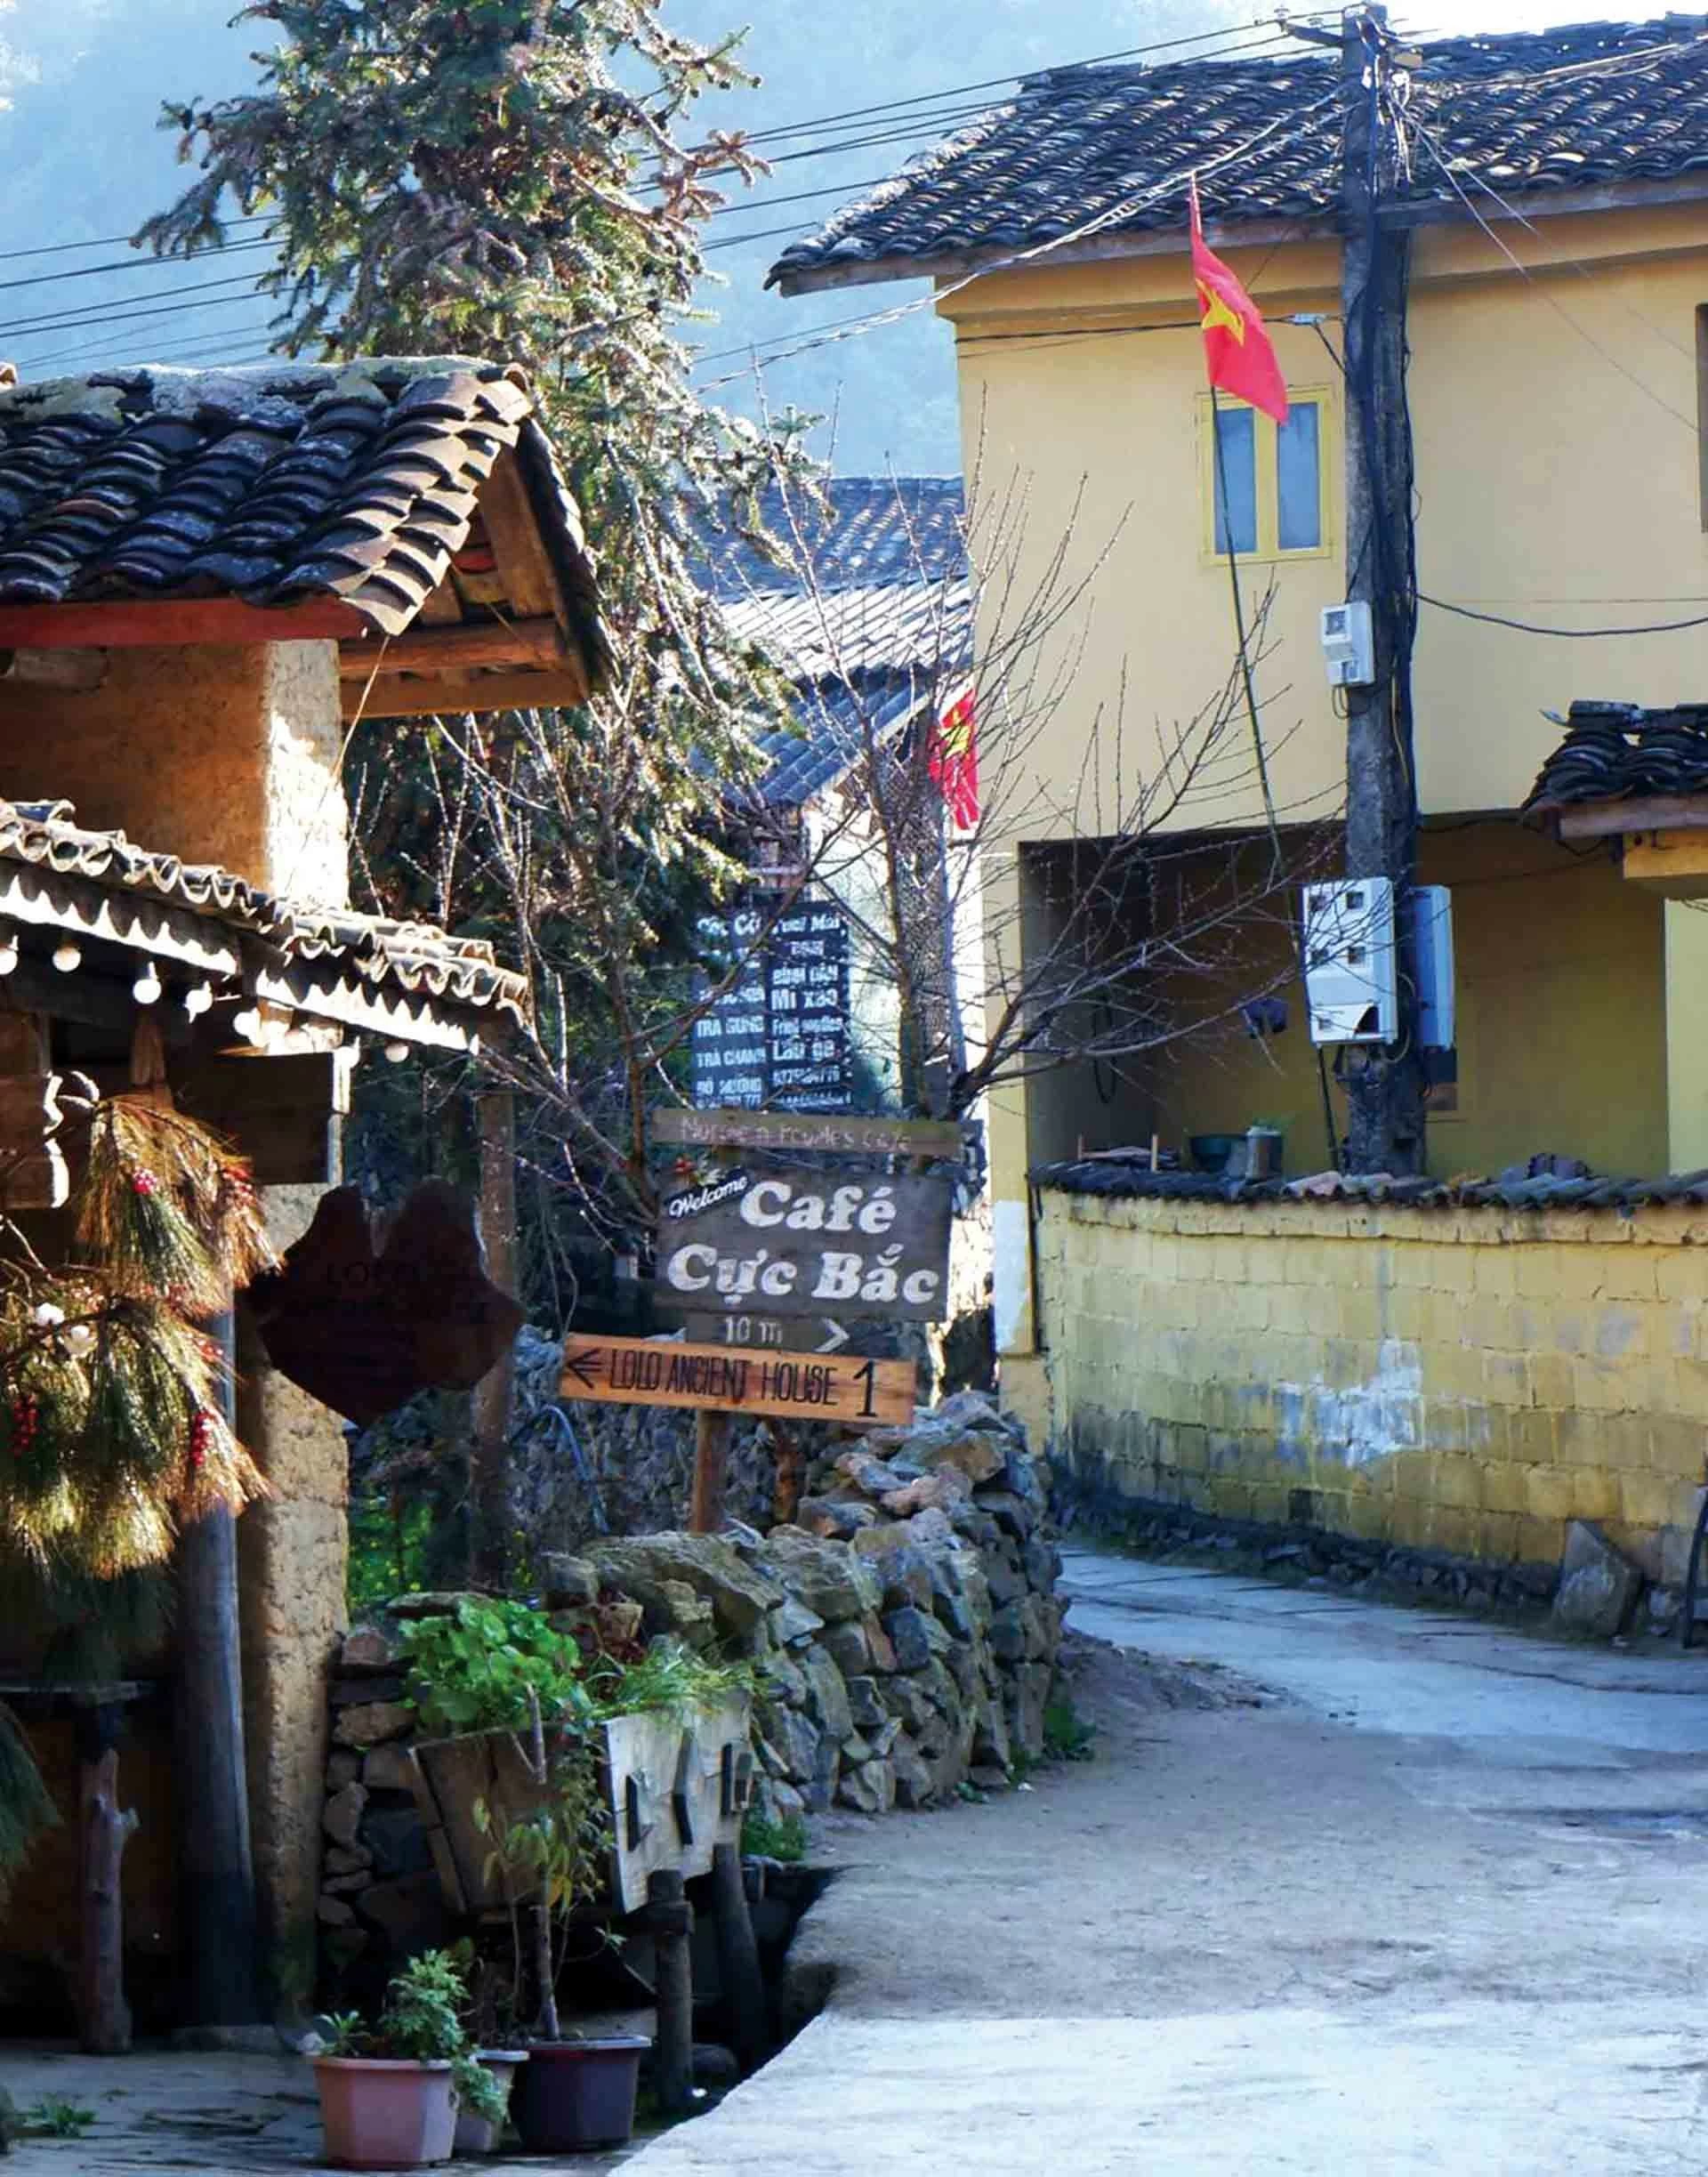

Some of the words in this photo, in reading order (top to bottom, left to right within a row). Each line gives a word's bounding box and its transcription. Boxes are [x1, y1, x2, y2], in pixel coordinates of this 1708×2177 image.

[668, 1175, 748, 1218] Welcome
[740, 1181, 897, 1234] Café
[667, 1244, 798, 1305] Cực
[810, 1243, 940, 1304] Bắc
[724, 1316, 751, 1343] 10
[759, 1319, 783, 1344] m
[609, 1348, 662, 1391] LOLO
[665, 1352, 752, 1402] ANCIENT
[761, 1360, 839, 1407] HOUSE
[852, 1359, 880, 1418] 1
